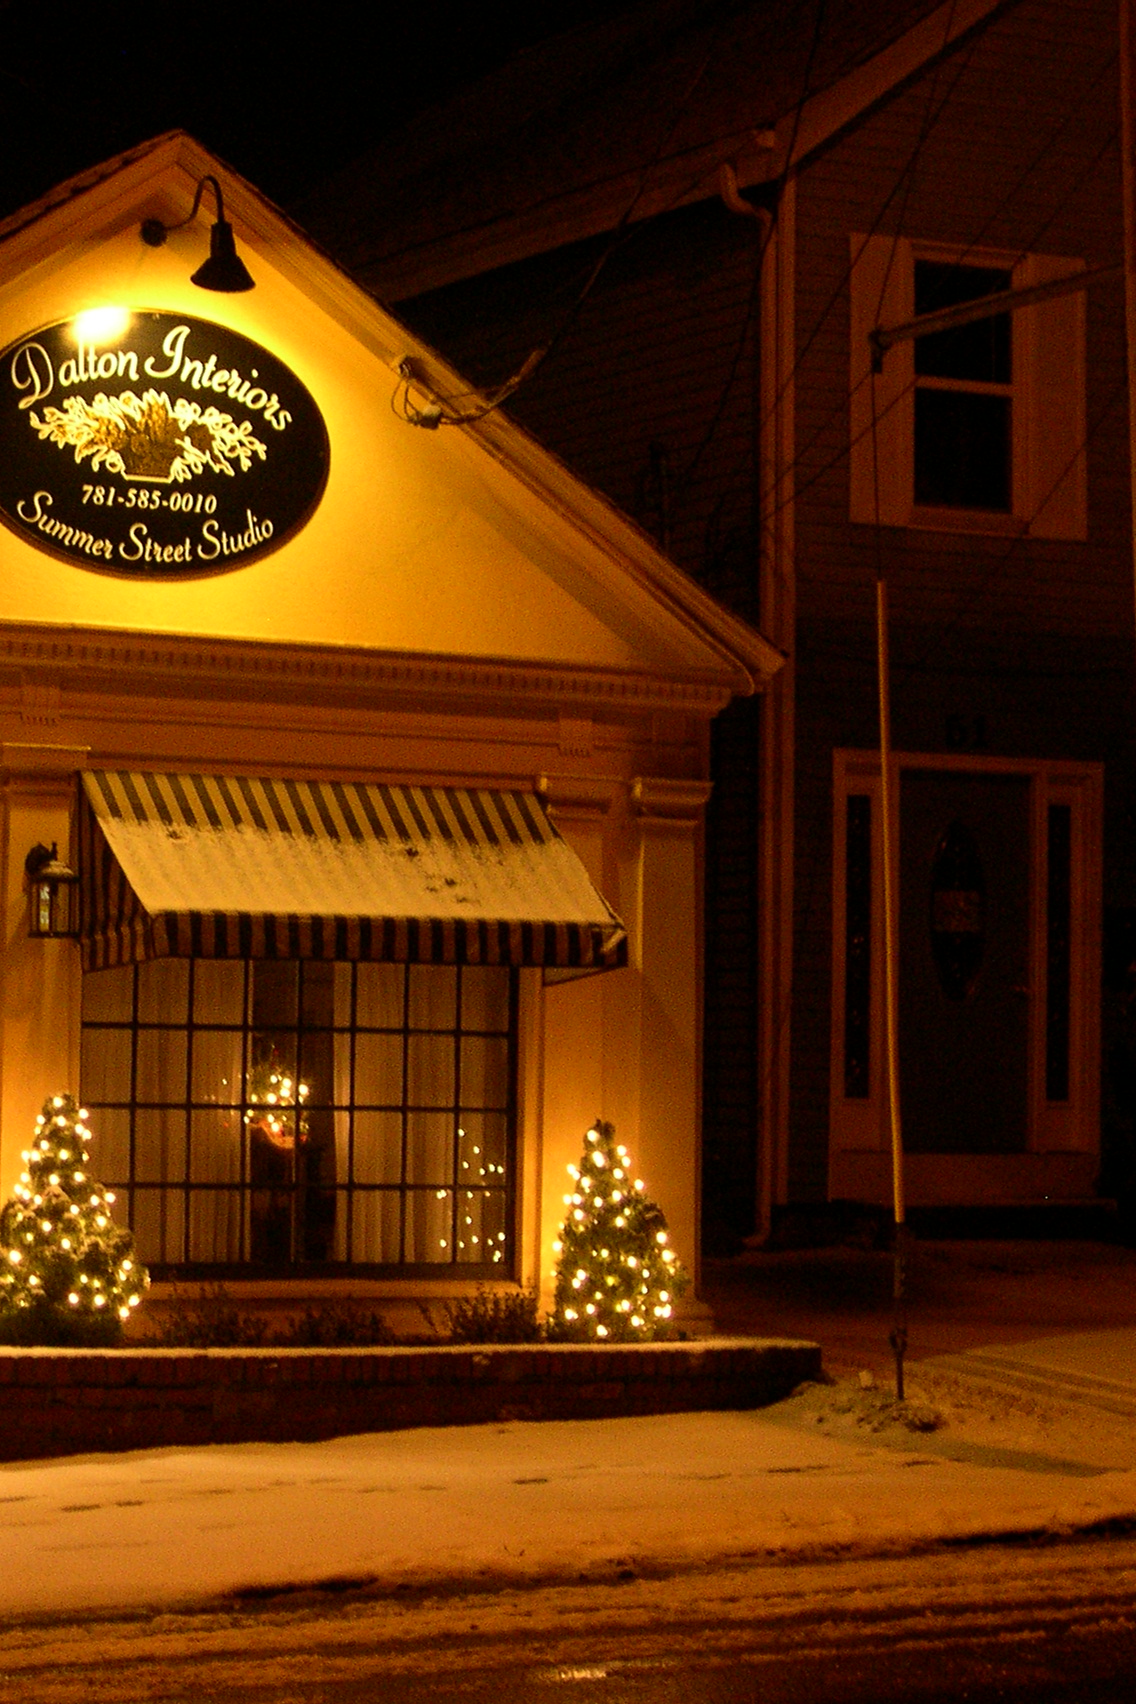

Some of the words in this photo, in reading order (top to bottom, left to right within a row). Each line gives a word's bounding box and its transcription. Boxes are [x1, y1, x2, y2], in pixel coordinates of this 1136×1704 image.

[10, 341, 140, 409] Dalton
[145, 325, 292, 431] Interiors
[17, 490, 114, 560] Summer
[120, 523, 193, 563] Street
[197, 508, 275, 561] Studio
[81, 484, 218, 514] 781-585-0010
